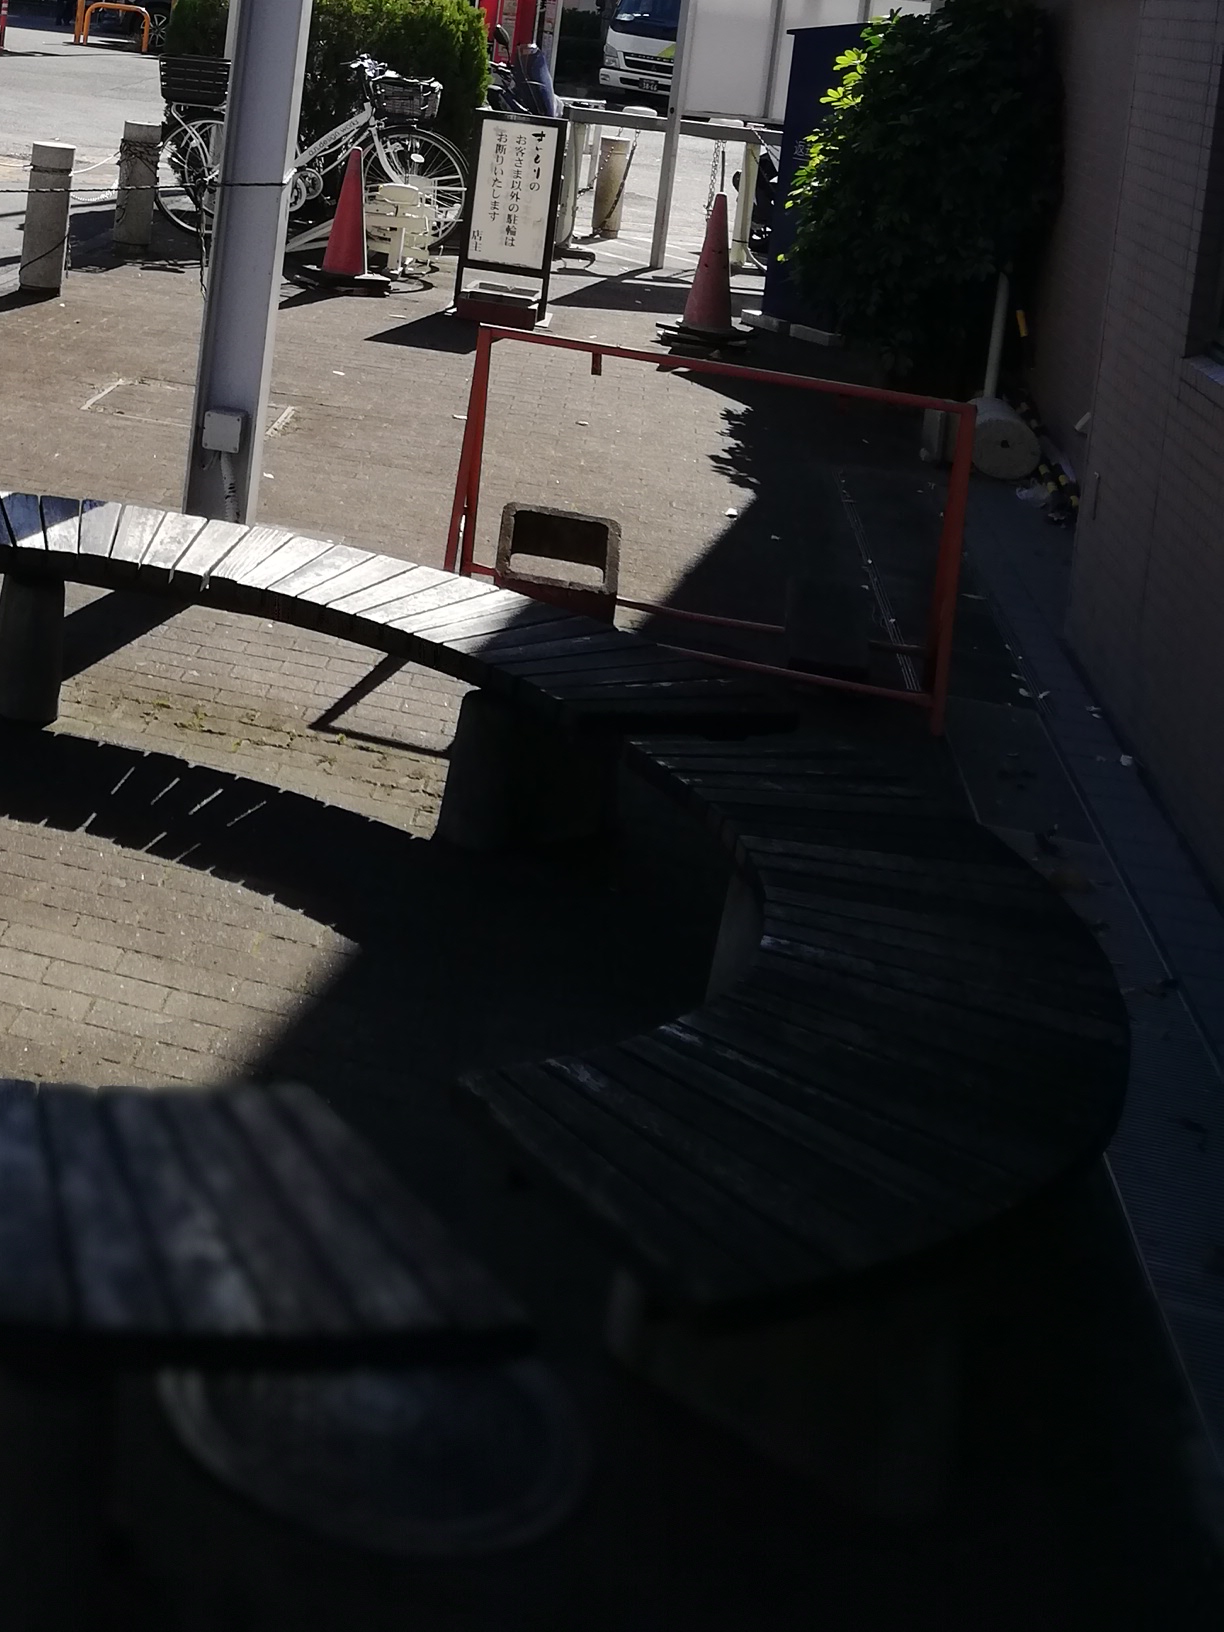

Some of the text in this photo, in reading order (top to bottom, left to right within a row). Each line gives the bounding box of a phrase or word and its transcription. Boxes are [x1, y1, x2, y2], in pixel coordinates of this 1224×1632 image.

[488, 132, 508, 223] お断りいたします
[504, 134, 527, 248] お客さま以外の駐輪は
